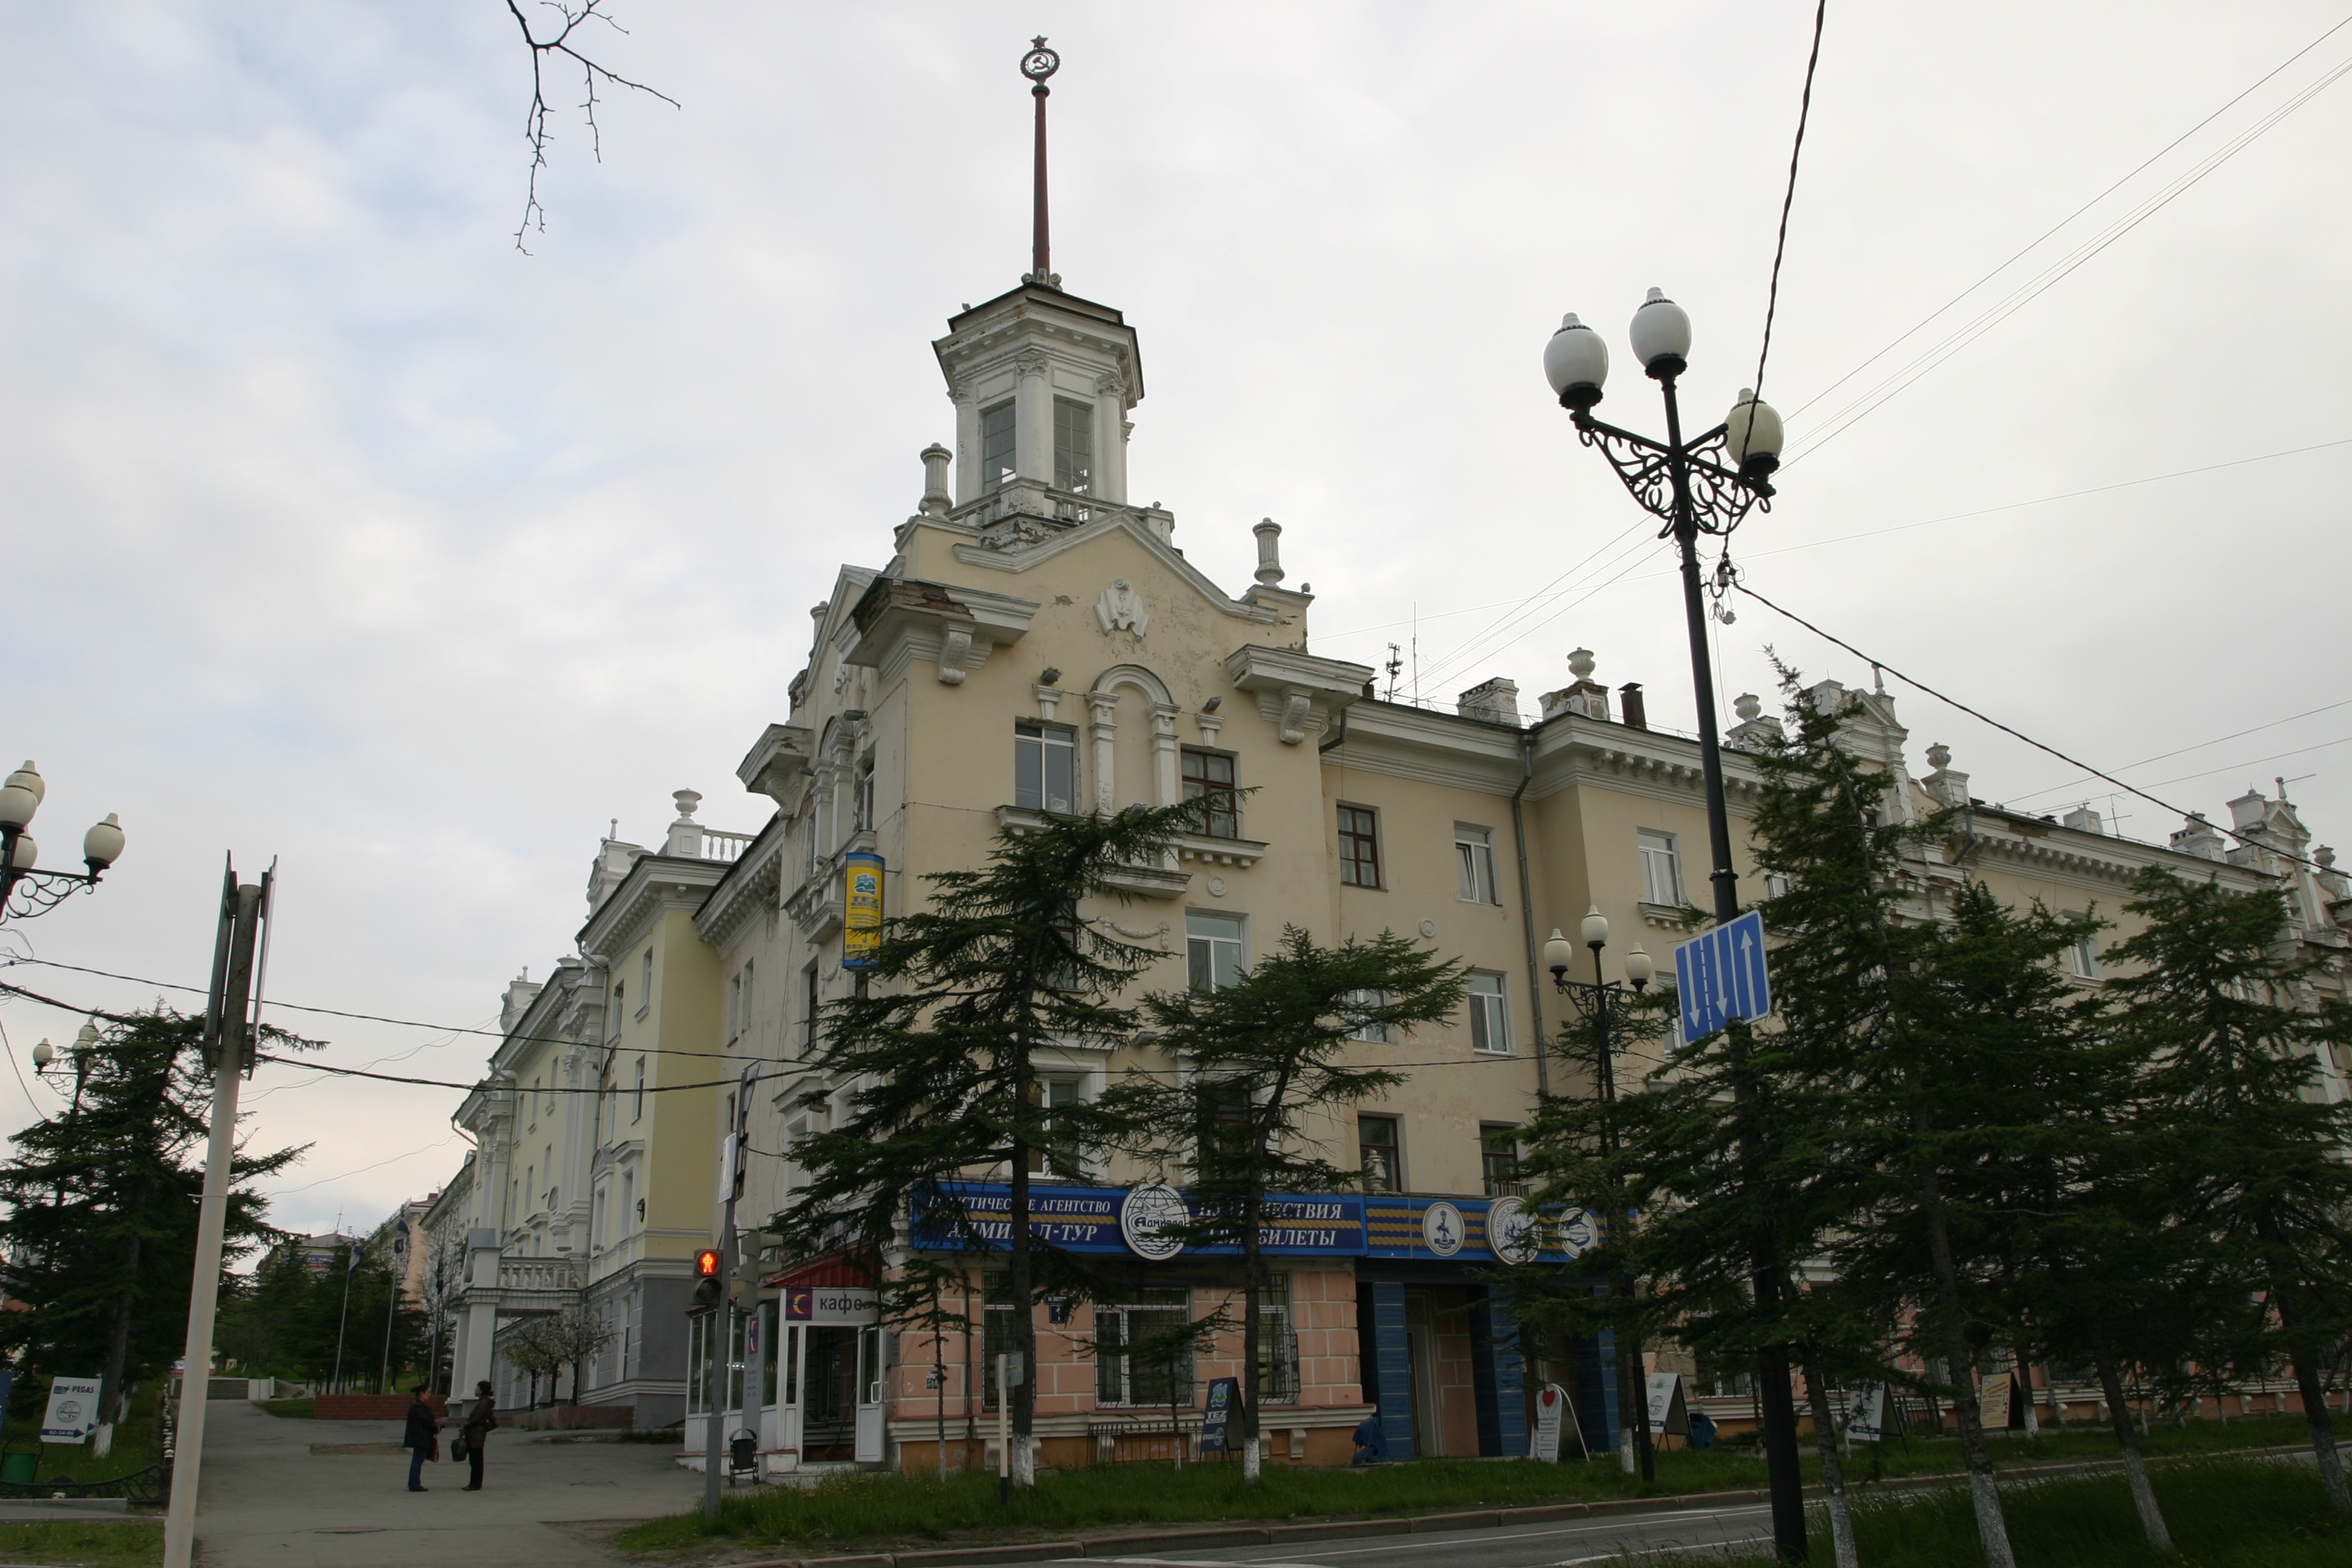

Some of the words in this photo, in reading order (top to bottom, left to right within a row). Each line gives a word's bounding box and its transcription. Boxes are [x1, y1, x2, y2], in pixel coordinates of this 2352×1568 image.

[1040, 1197, 1111, 1214] АГЕНТСТВО
[819, 1294, 862, 1315] кафе
[71, 1385, 95, 1393] PEGAS
[1207, 1410, 1227, 1419] TEZ
